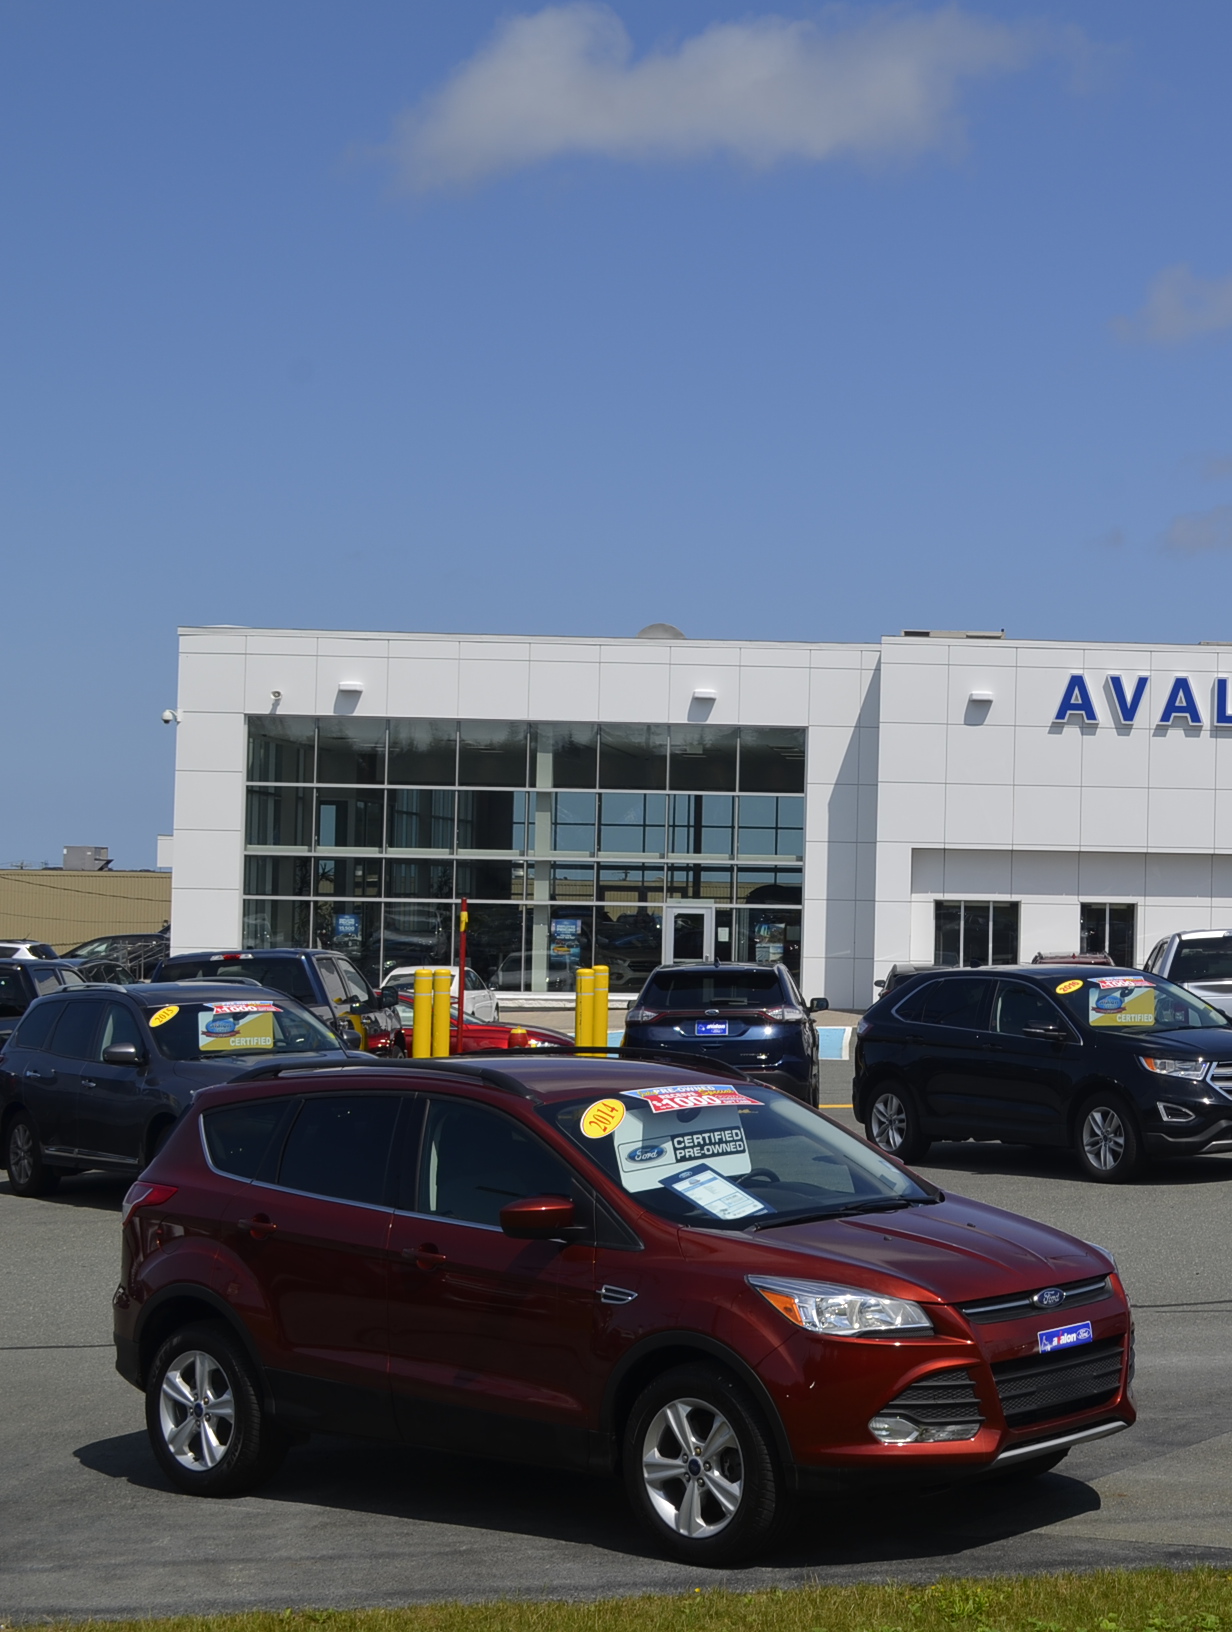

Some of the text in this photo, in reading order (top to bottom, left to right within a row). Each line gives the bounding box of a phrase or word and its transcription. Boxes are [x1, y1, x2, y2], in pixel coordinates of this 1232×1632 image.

[155, 1008, 174, 1024] 2015
[1116, 1013, 1153, 1022] CERTIFIED
[229, 1037, 272, 1046] CERTIFIED
[589, 1102, 619, 1132] 2014
[674, 1129, 742, 1149] CERTIFIED
[635, 1149, 658, 1161] Ford
[676, 1141, 744, 1160] PRE-OWNED
[1043, 1291, 1060, 1304] Ford
